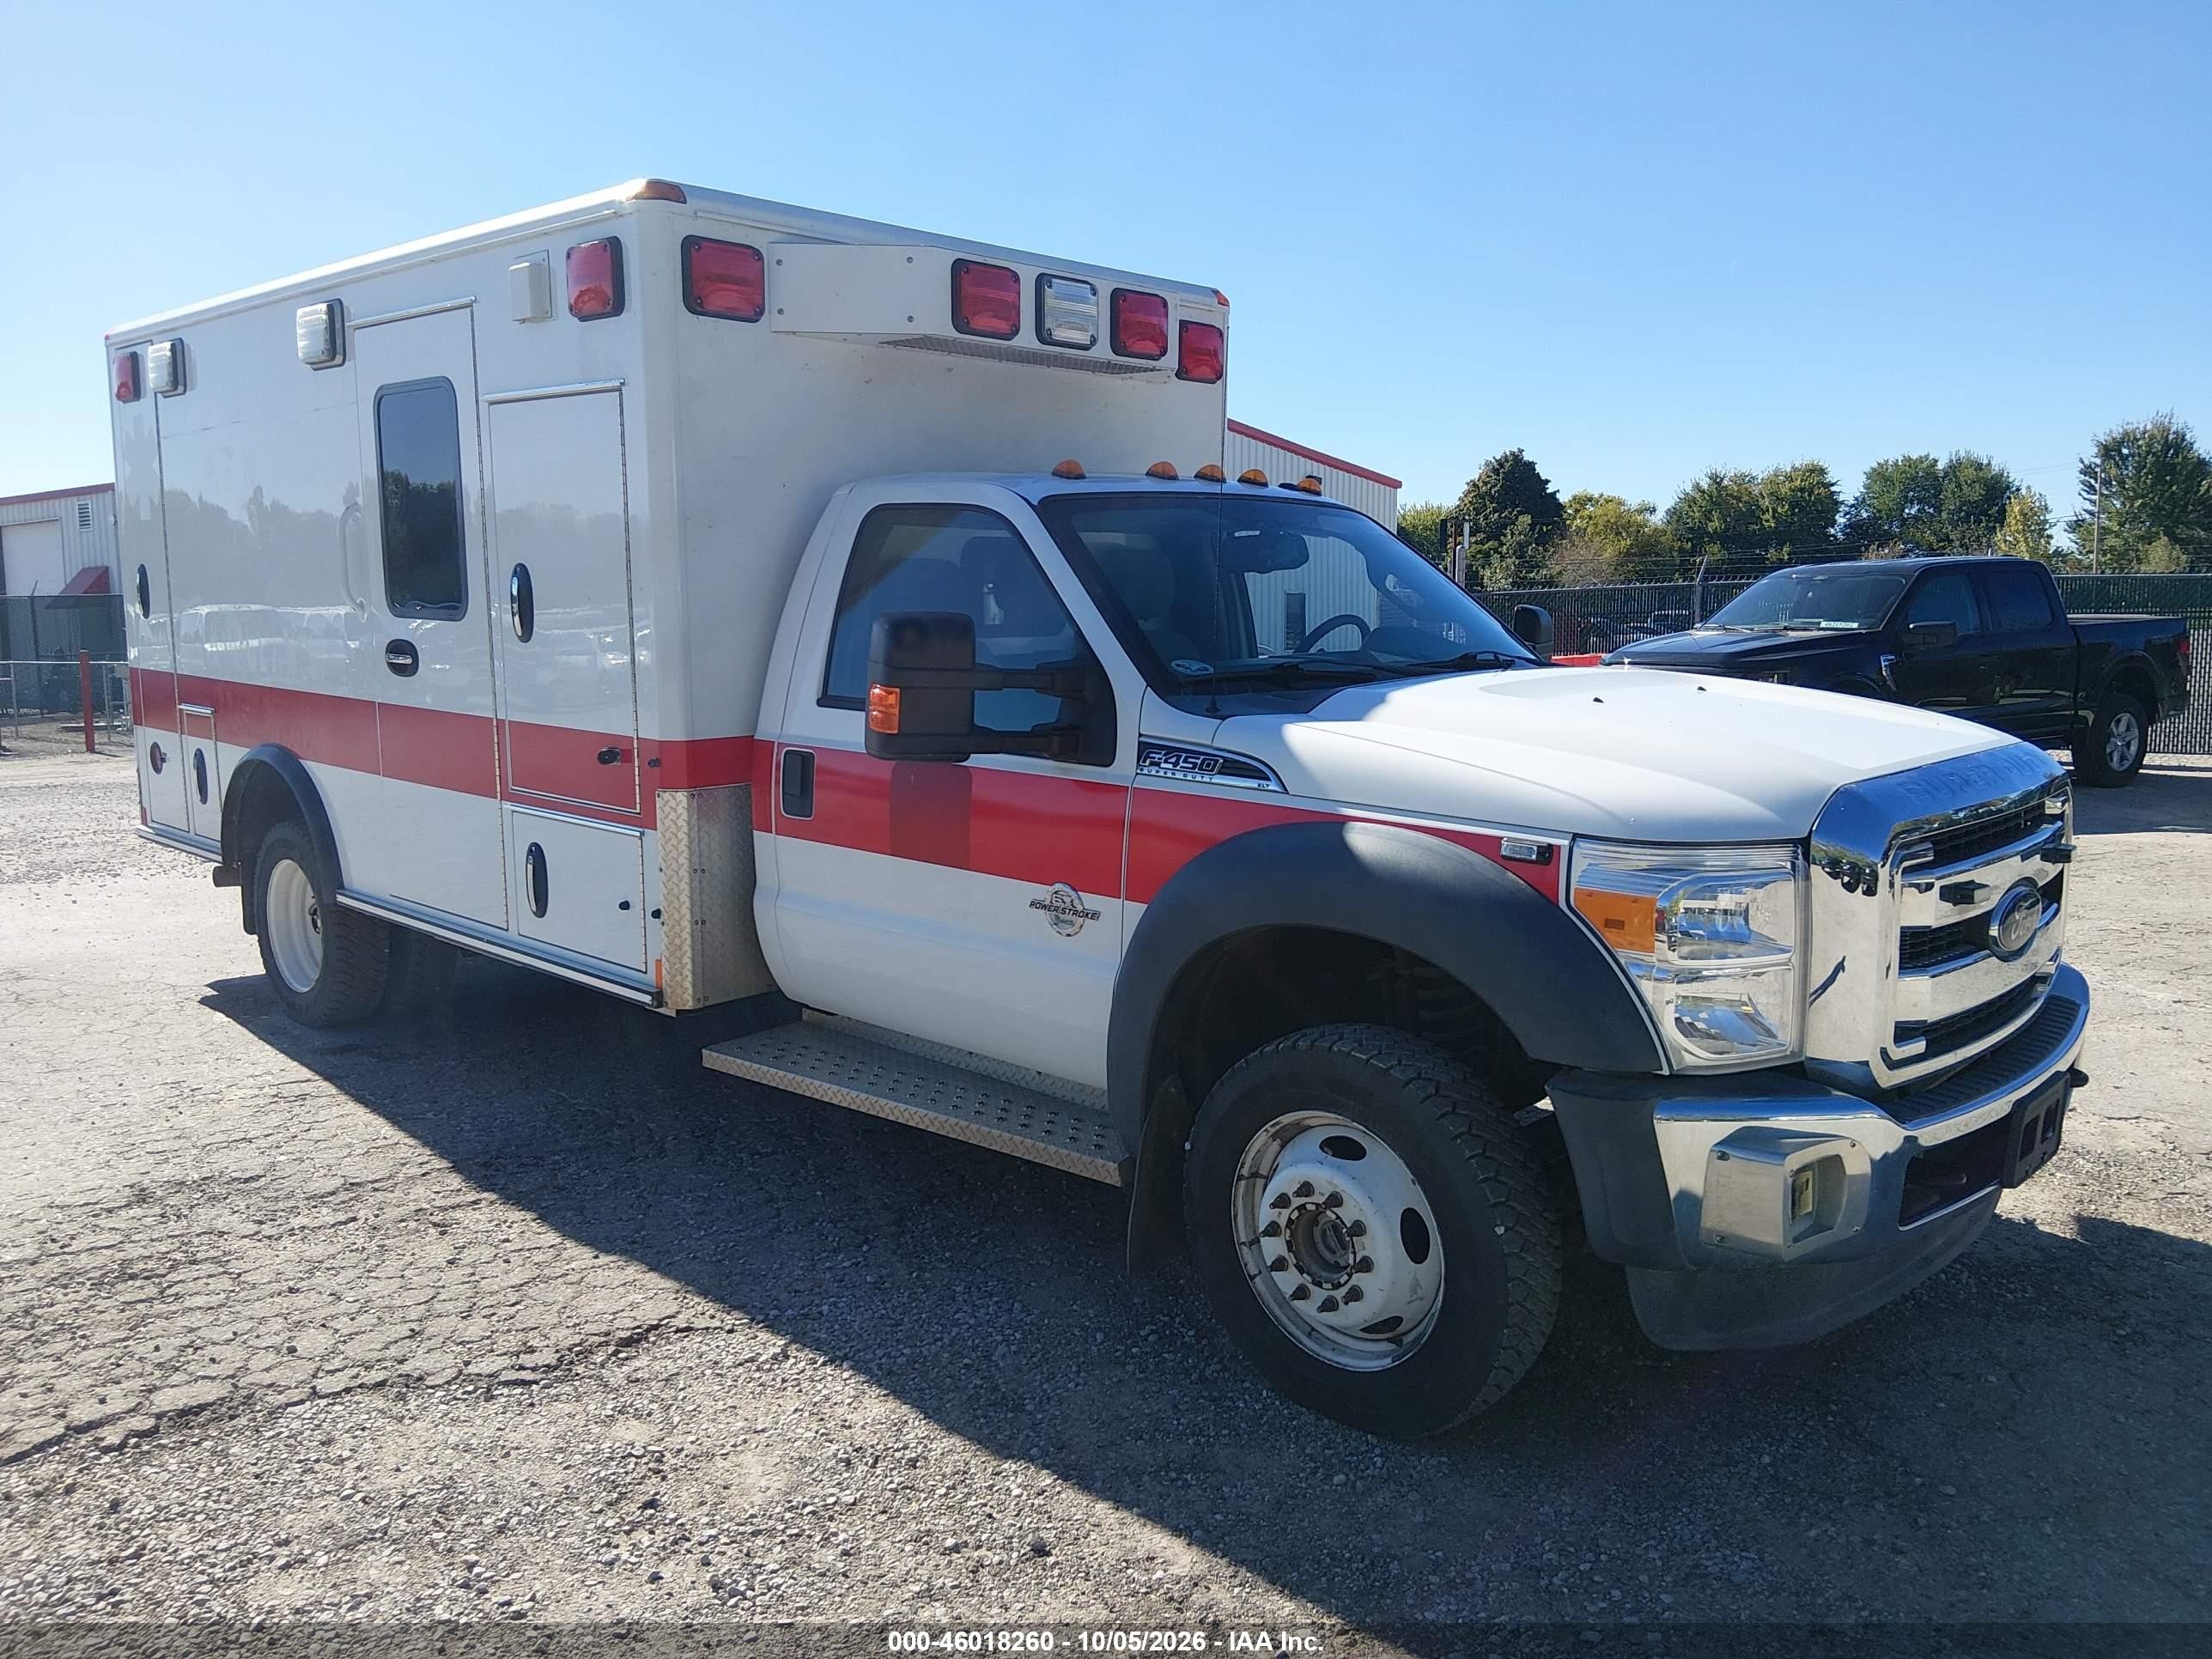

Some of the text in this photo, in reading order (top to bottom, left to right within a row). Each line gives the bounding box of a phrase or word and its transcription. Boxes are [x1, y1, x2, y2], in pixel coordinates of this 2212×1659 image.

[1139, 750, 1224, 776] F-450
[1139, 768, 1214, 782] SUPER DUTY
